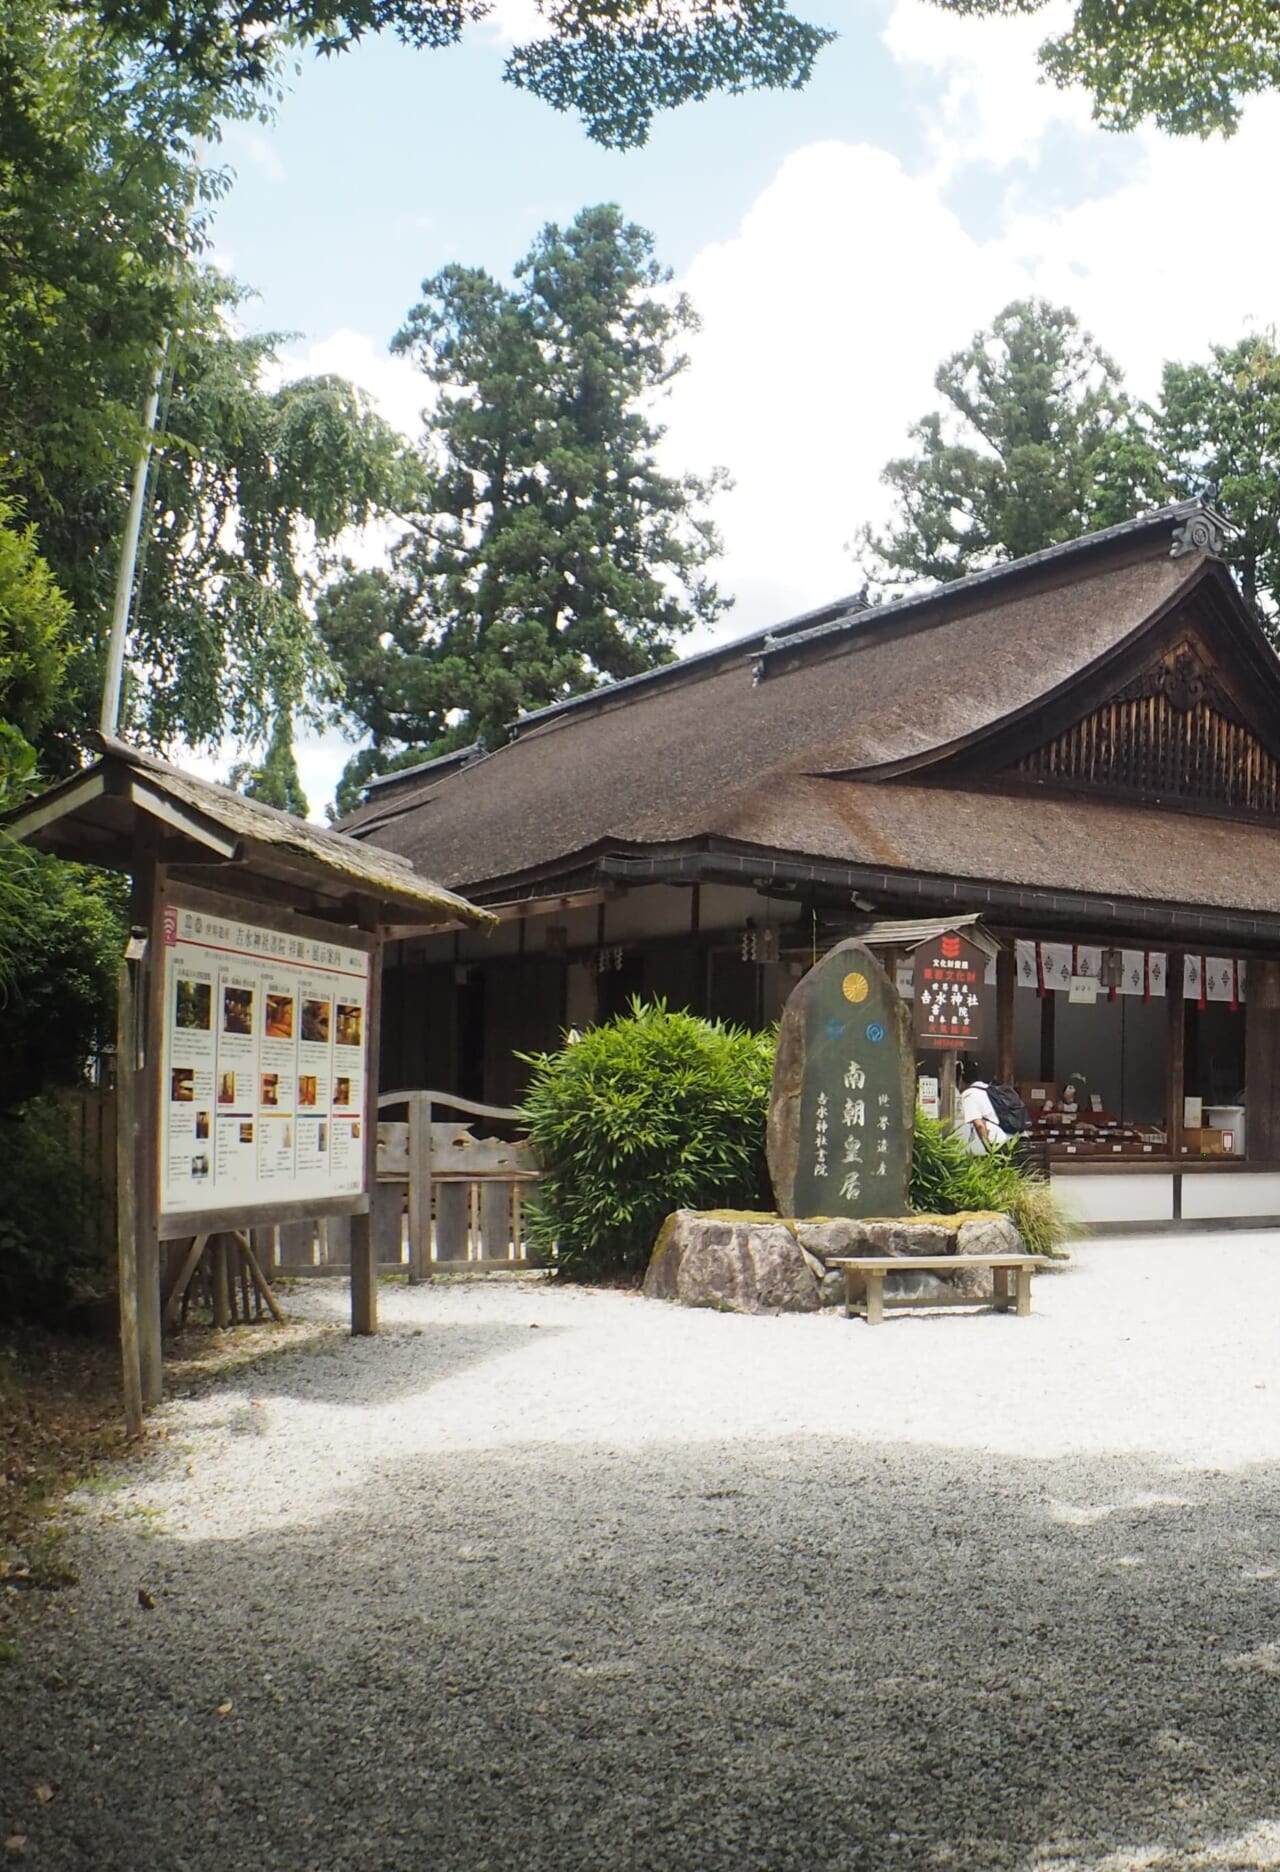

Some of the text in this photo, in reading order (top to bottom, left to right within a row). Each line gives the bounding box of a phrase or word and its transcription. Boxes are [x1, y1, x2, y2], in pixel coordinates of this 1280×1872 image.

[923, 968, 976, 982] 重要文化財
[931, 982, 969, 994] 世界遺産
[813, 1091, 830, 1177] 吉水神社書院
[839, 1061, 866, 1201] 南朝皇居
[876, 1093, 890, 1177] 世界遺産
